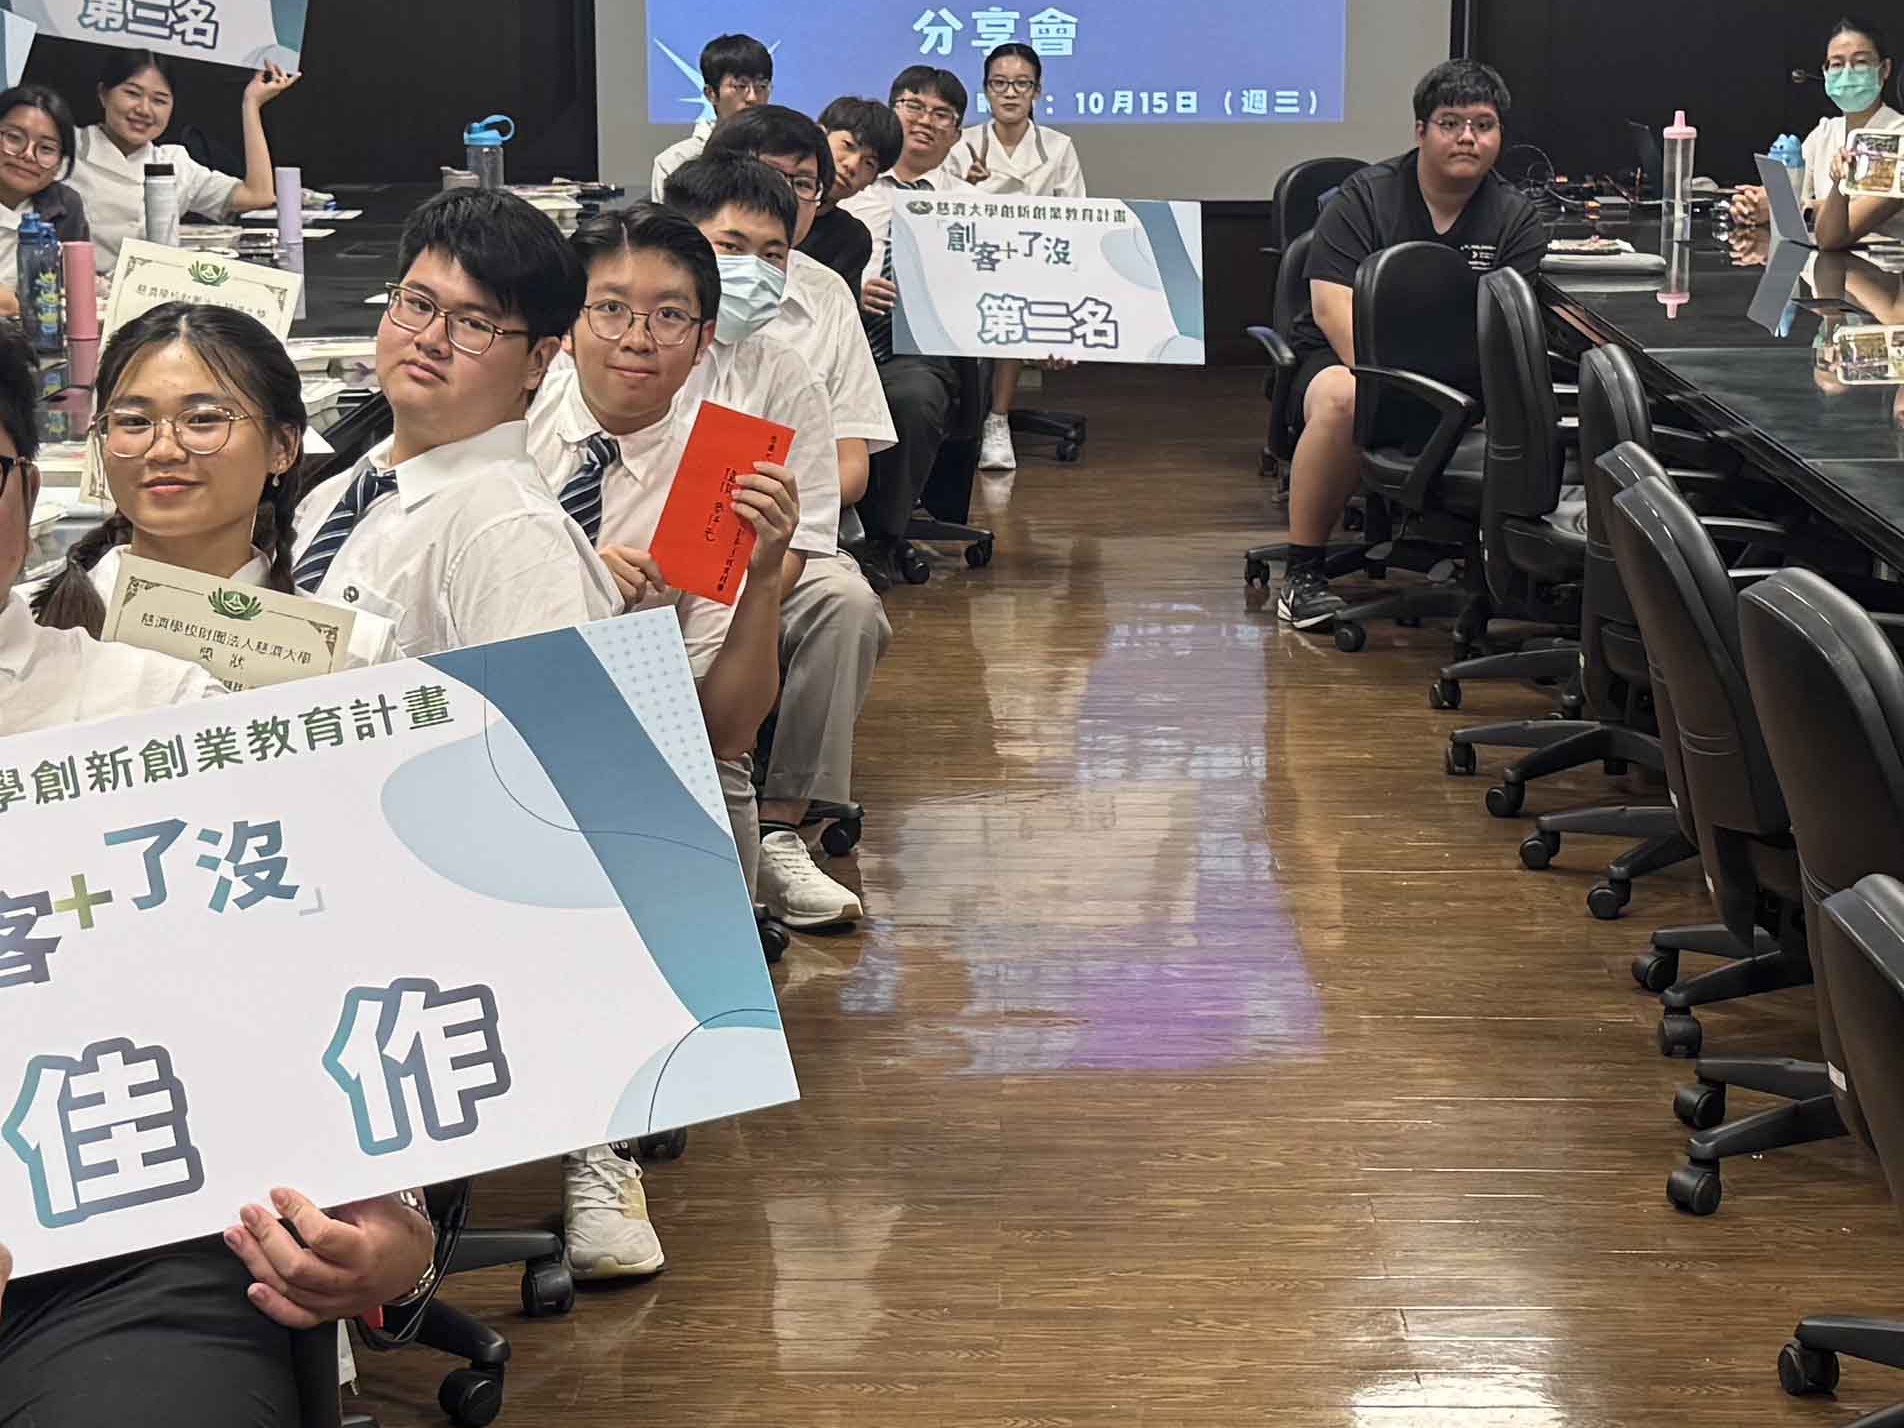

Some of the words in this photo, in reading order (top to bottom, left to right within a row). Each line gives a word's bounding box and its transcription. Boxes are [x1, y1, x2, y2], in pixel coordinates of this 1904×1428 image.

[912, 6, 1080, 57] 分享會
[976, 292, 1119, 349] 第二名
